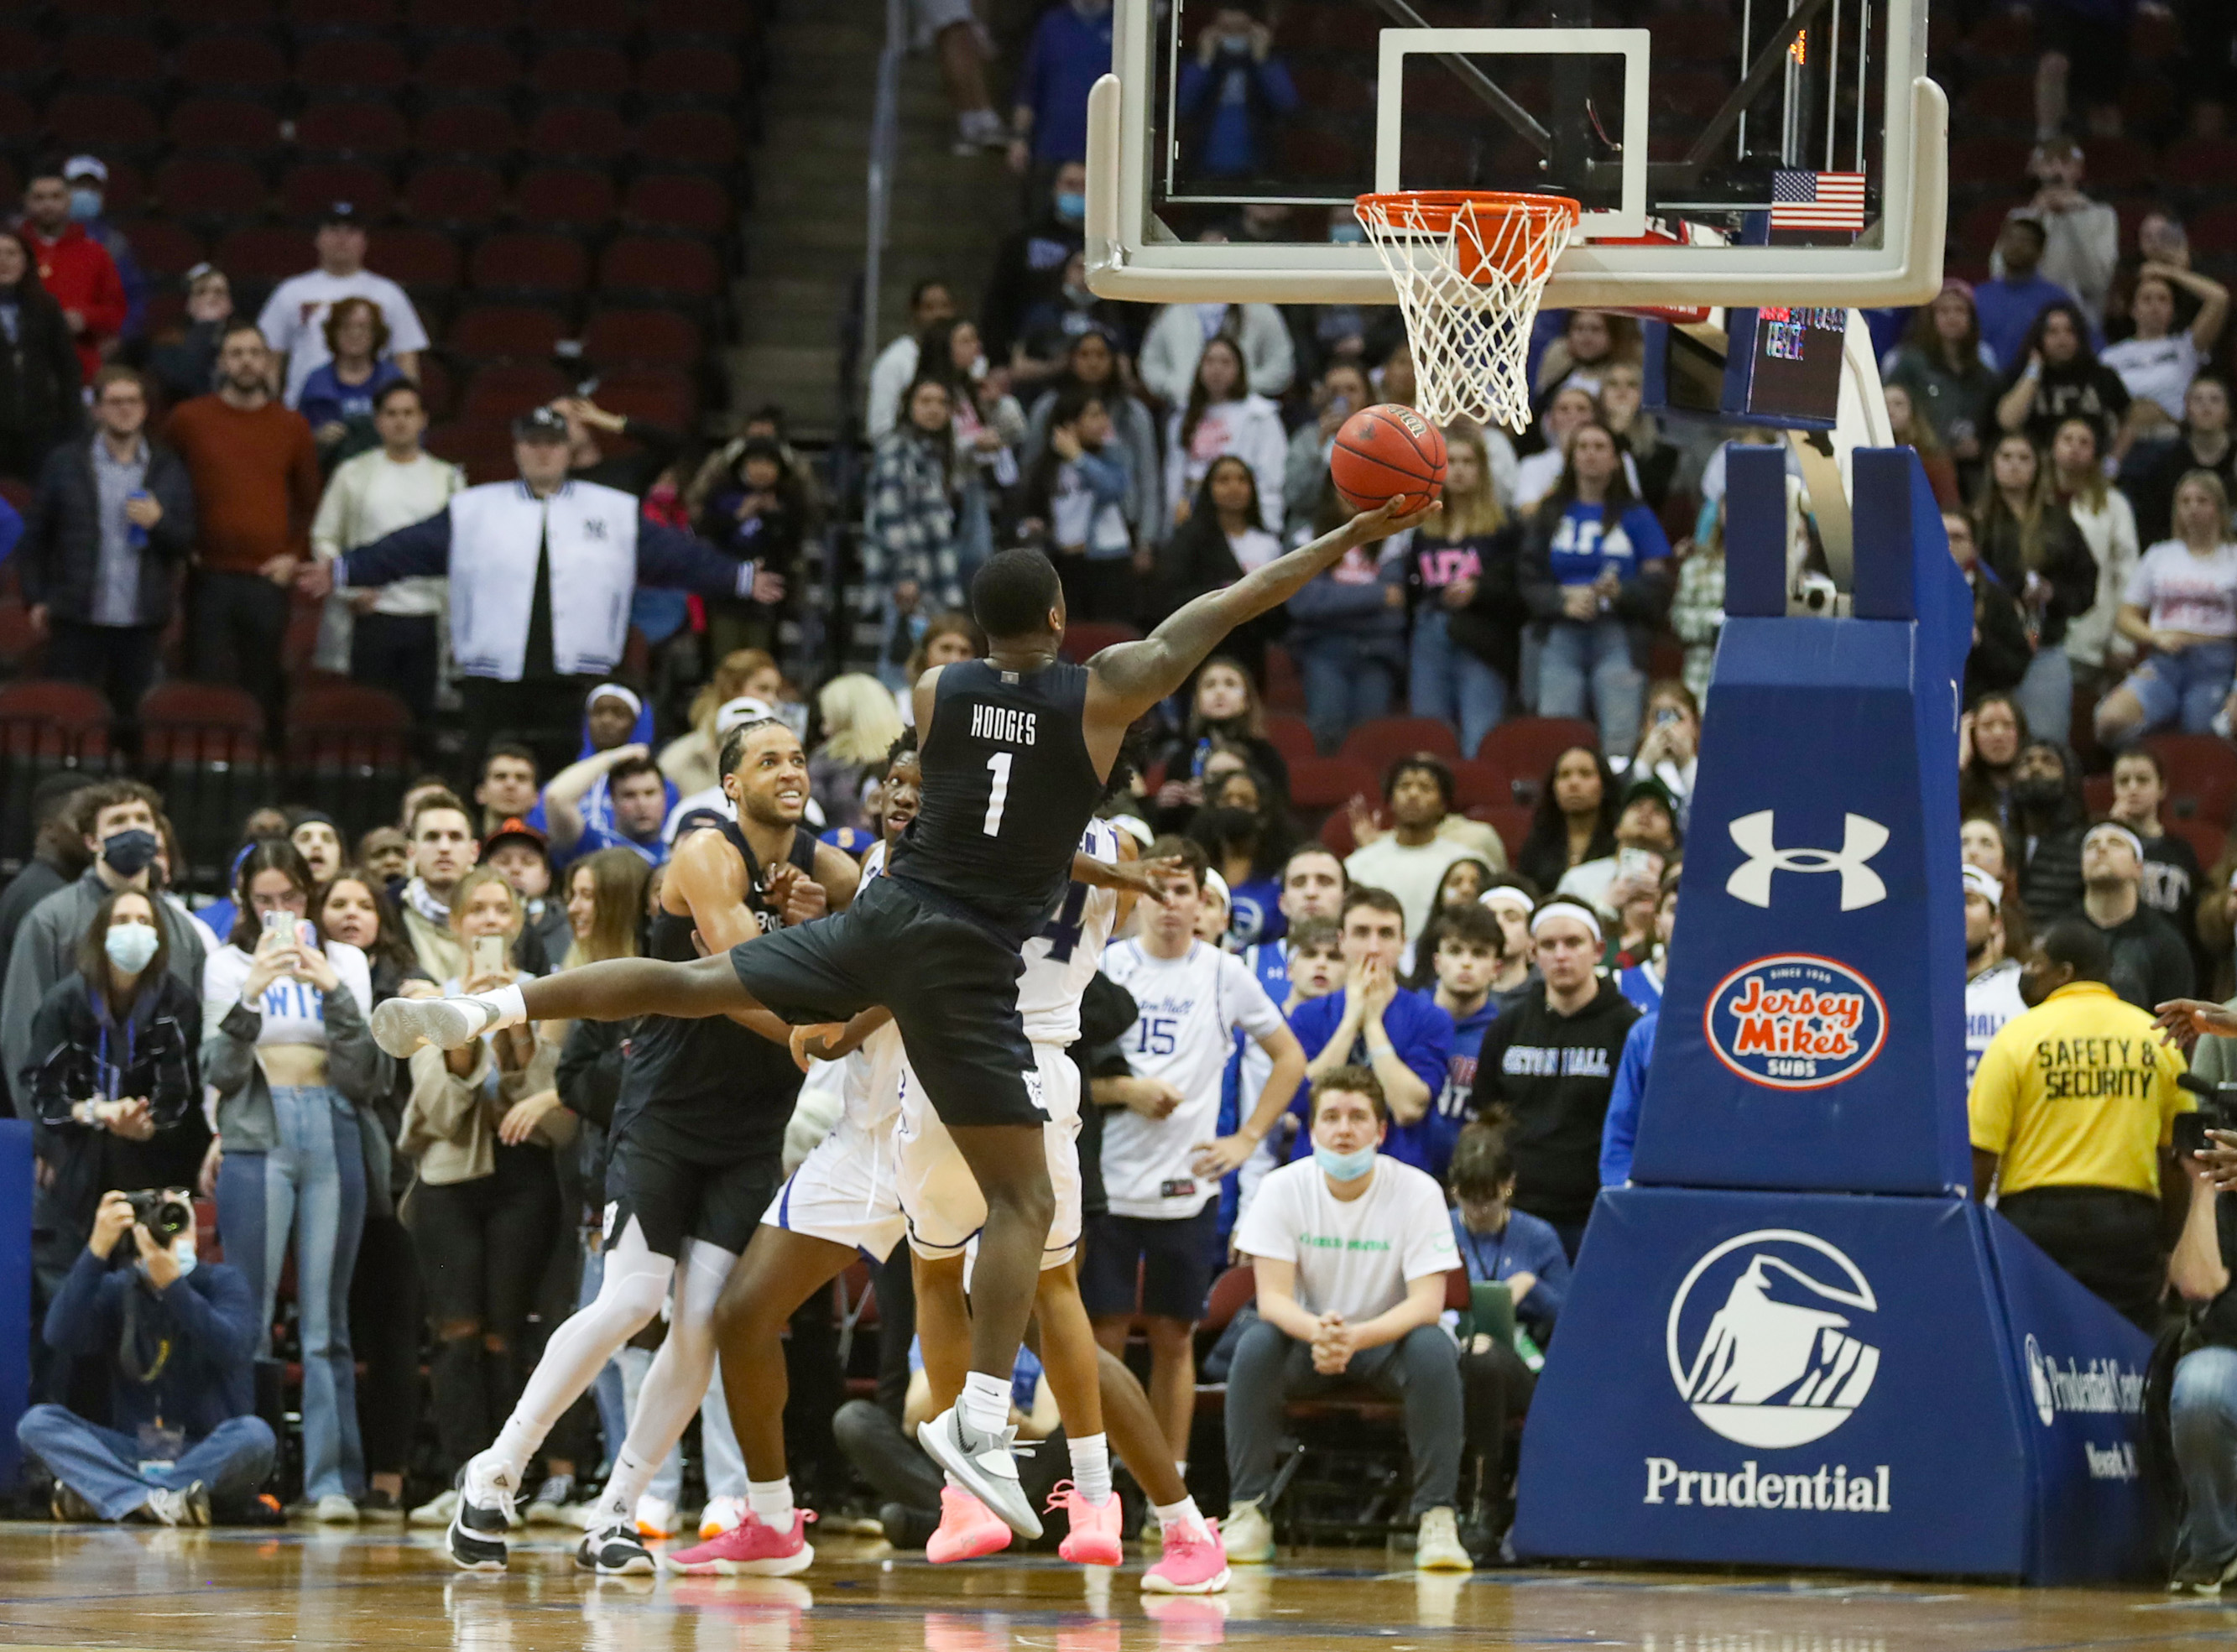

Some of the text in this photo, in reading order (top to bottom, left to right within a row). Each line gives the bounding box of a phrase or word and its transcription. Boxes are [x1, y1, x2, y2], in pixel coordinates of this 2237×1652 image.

[971, 704, 1036, 745] HODGES
[983, 751, 1013, 837] 1
[1731, 978, 1862, 1029] Jersey
[1137, 1017, 1177, 1055] 15
[1734, 1017, 1857, 1056] Mike's
[2038, 1037, 2156, 1069] SAFETY &
[1767, 1059, 1817, 1077] SUBS
[2046, 1069, 2152, 1100] SECURITY
[1643, 1457, 1891, 1513] Prudential
